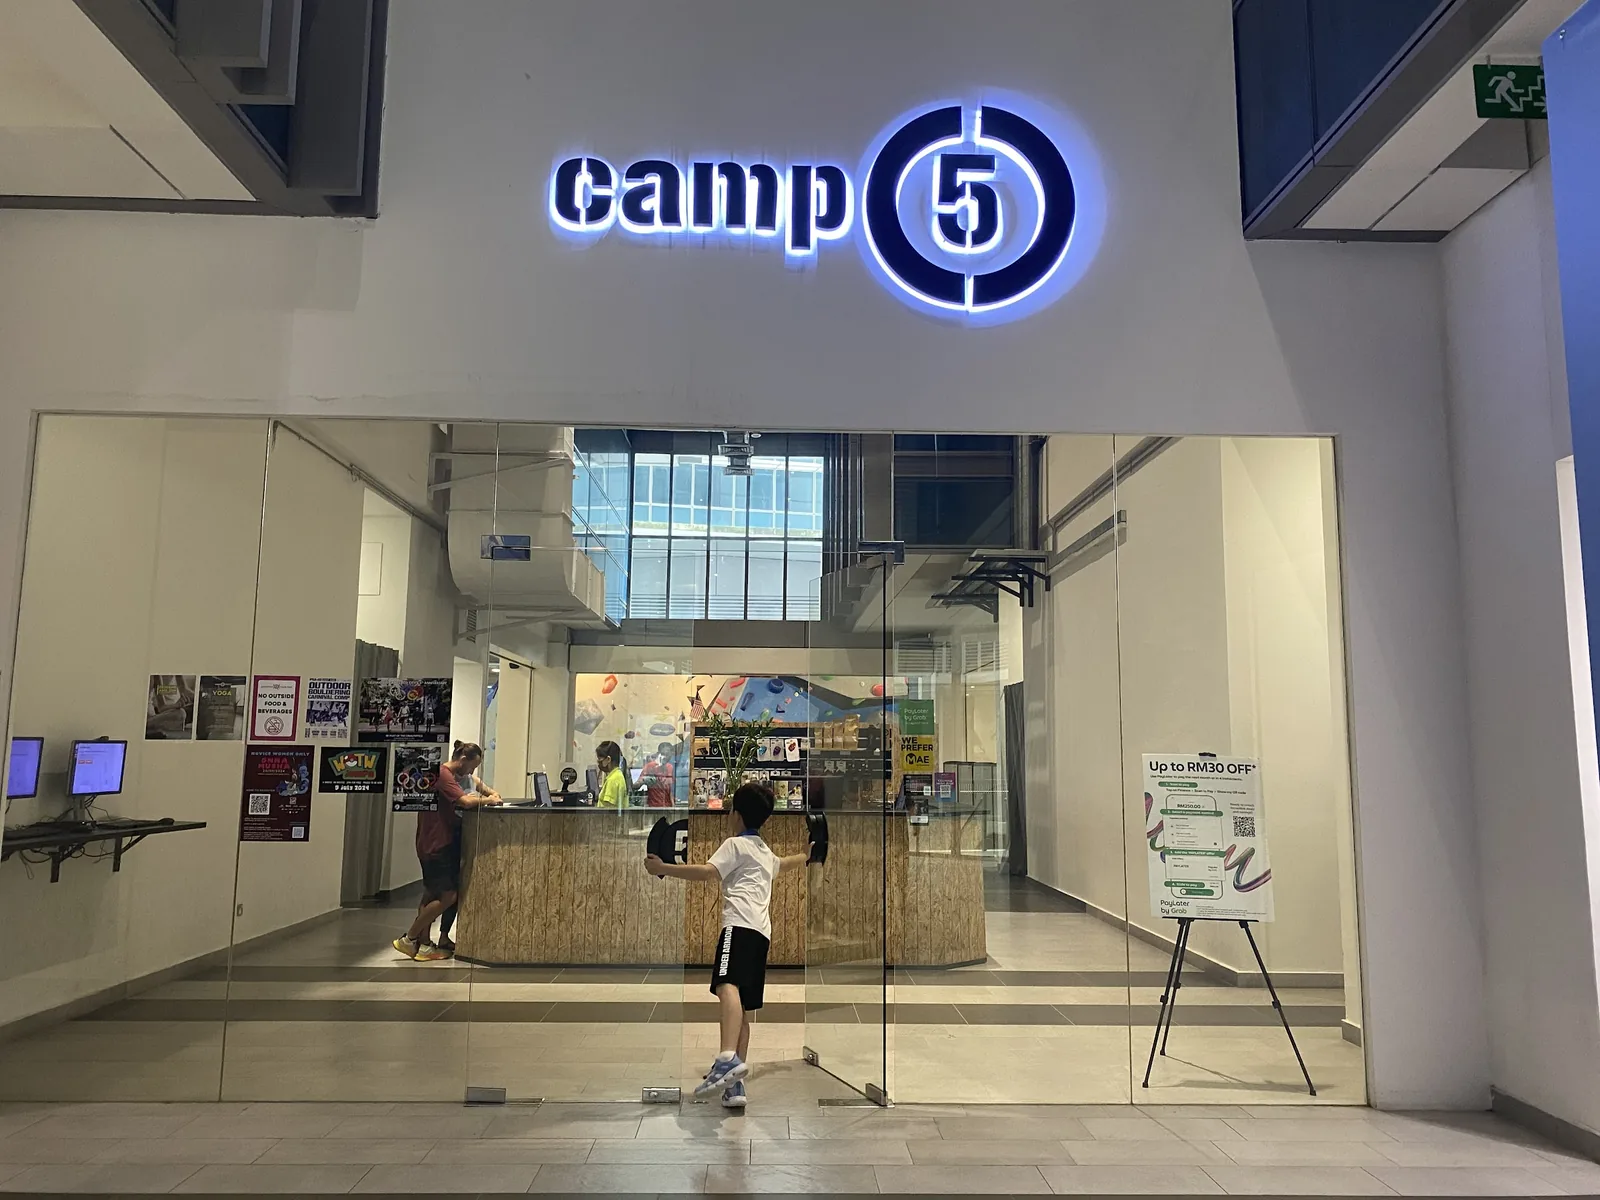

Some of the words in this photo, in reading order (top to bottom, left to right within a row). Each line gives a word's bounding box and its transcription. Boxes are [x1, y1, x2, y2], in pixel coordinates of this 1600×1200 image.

[554, 156, 848, 251] camp
[938, 153, 998, 249] 5
[308, 682, 351, 690] OUTDOOR
[906, 752, 930, 764] MAE
[1149, 761, 1168, 774] Up
[1170, 762, 1184, 772] to
[1188, 762, 1224, 774] RM30
[722, 924, 733, 953] ARMOU
[719, 954, 730, 976] UNDER
